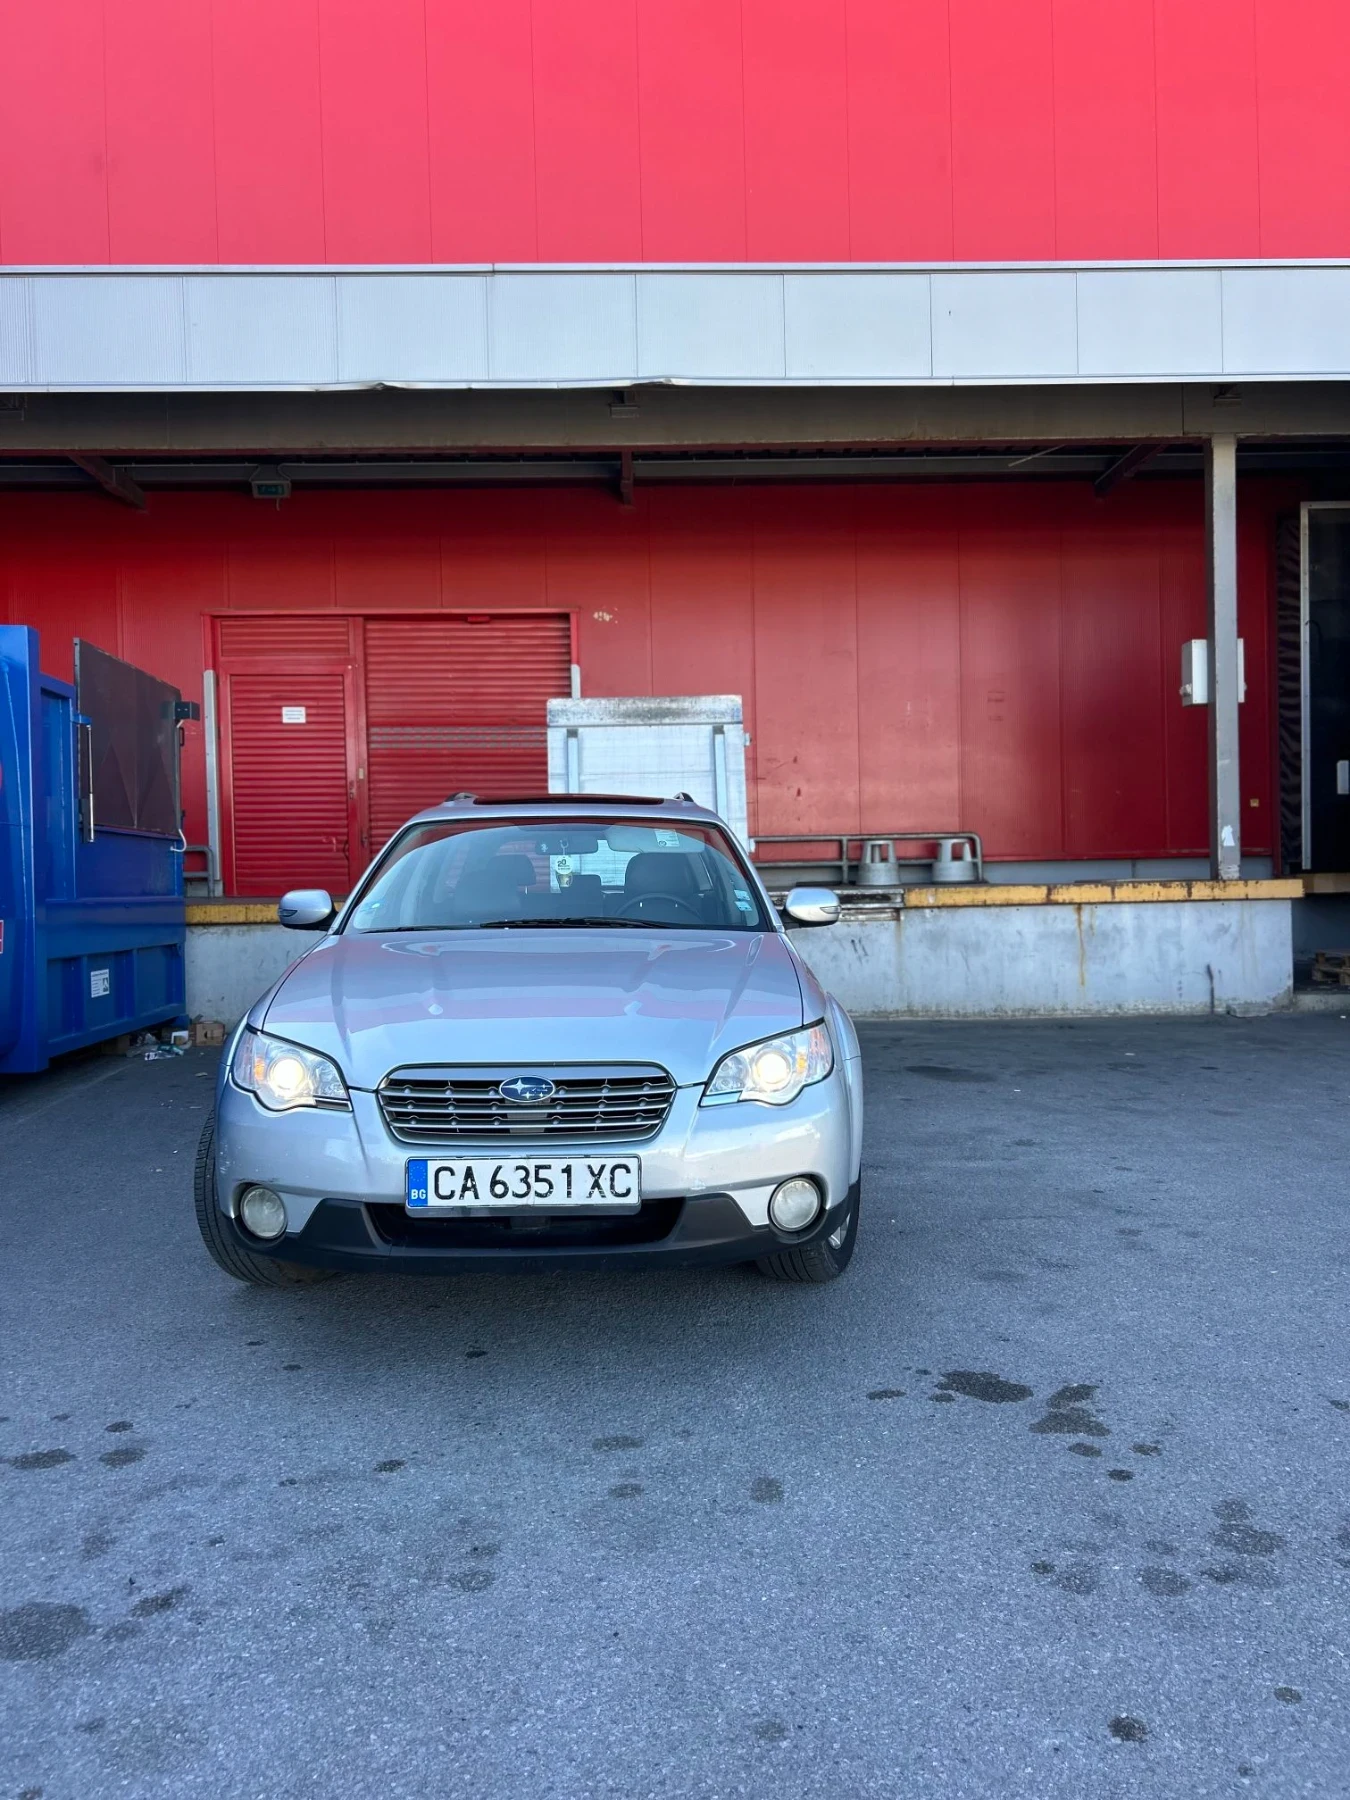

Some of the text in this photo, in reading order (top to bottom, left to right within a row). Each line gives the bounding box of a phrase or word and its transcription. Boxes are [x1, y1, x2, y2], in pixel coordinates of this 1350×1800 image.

[434, 1163, 631, 1200] CA 6351 XC
[411, 1189, 426, 1199] BG
